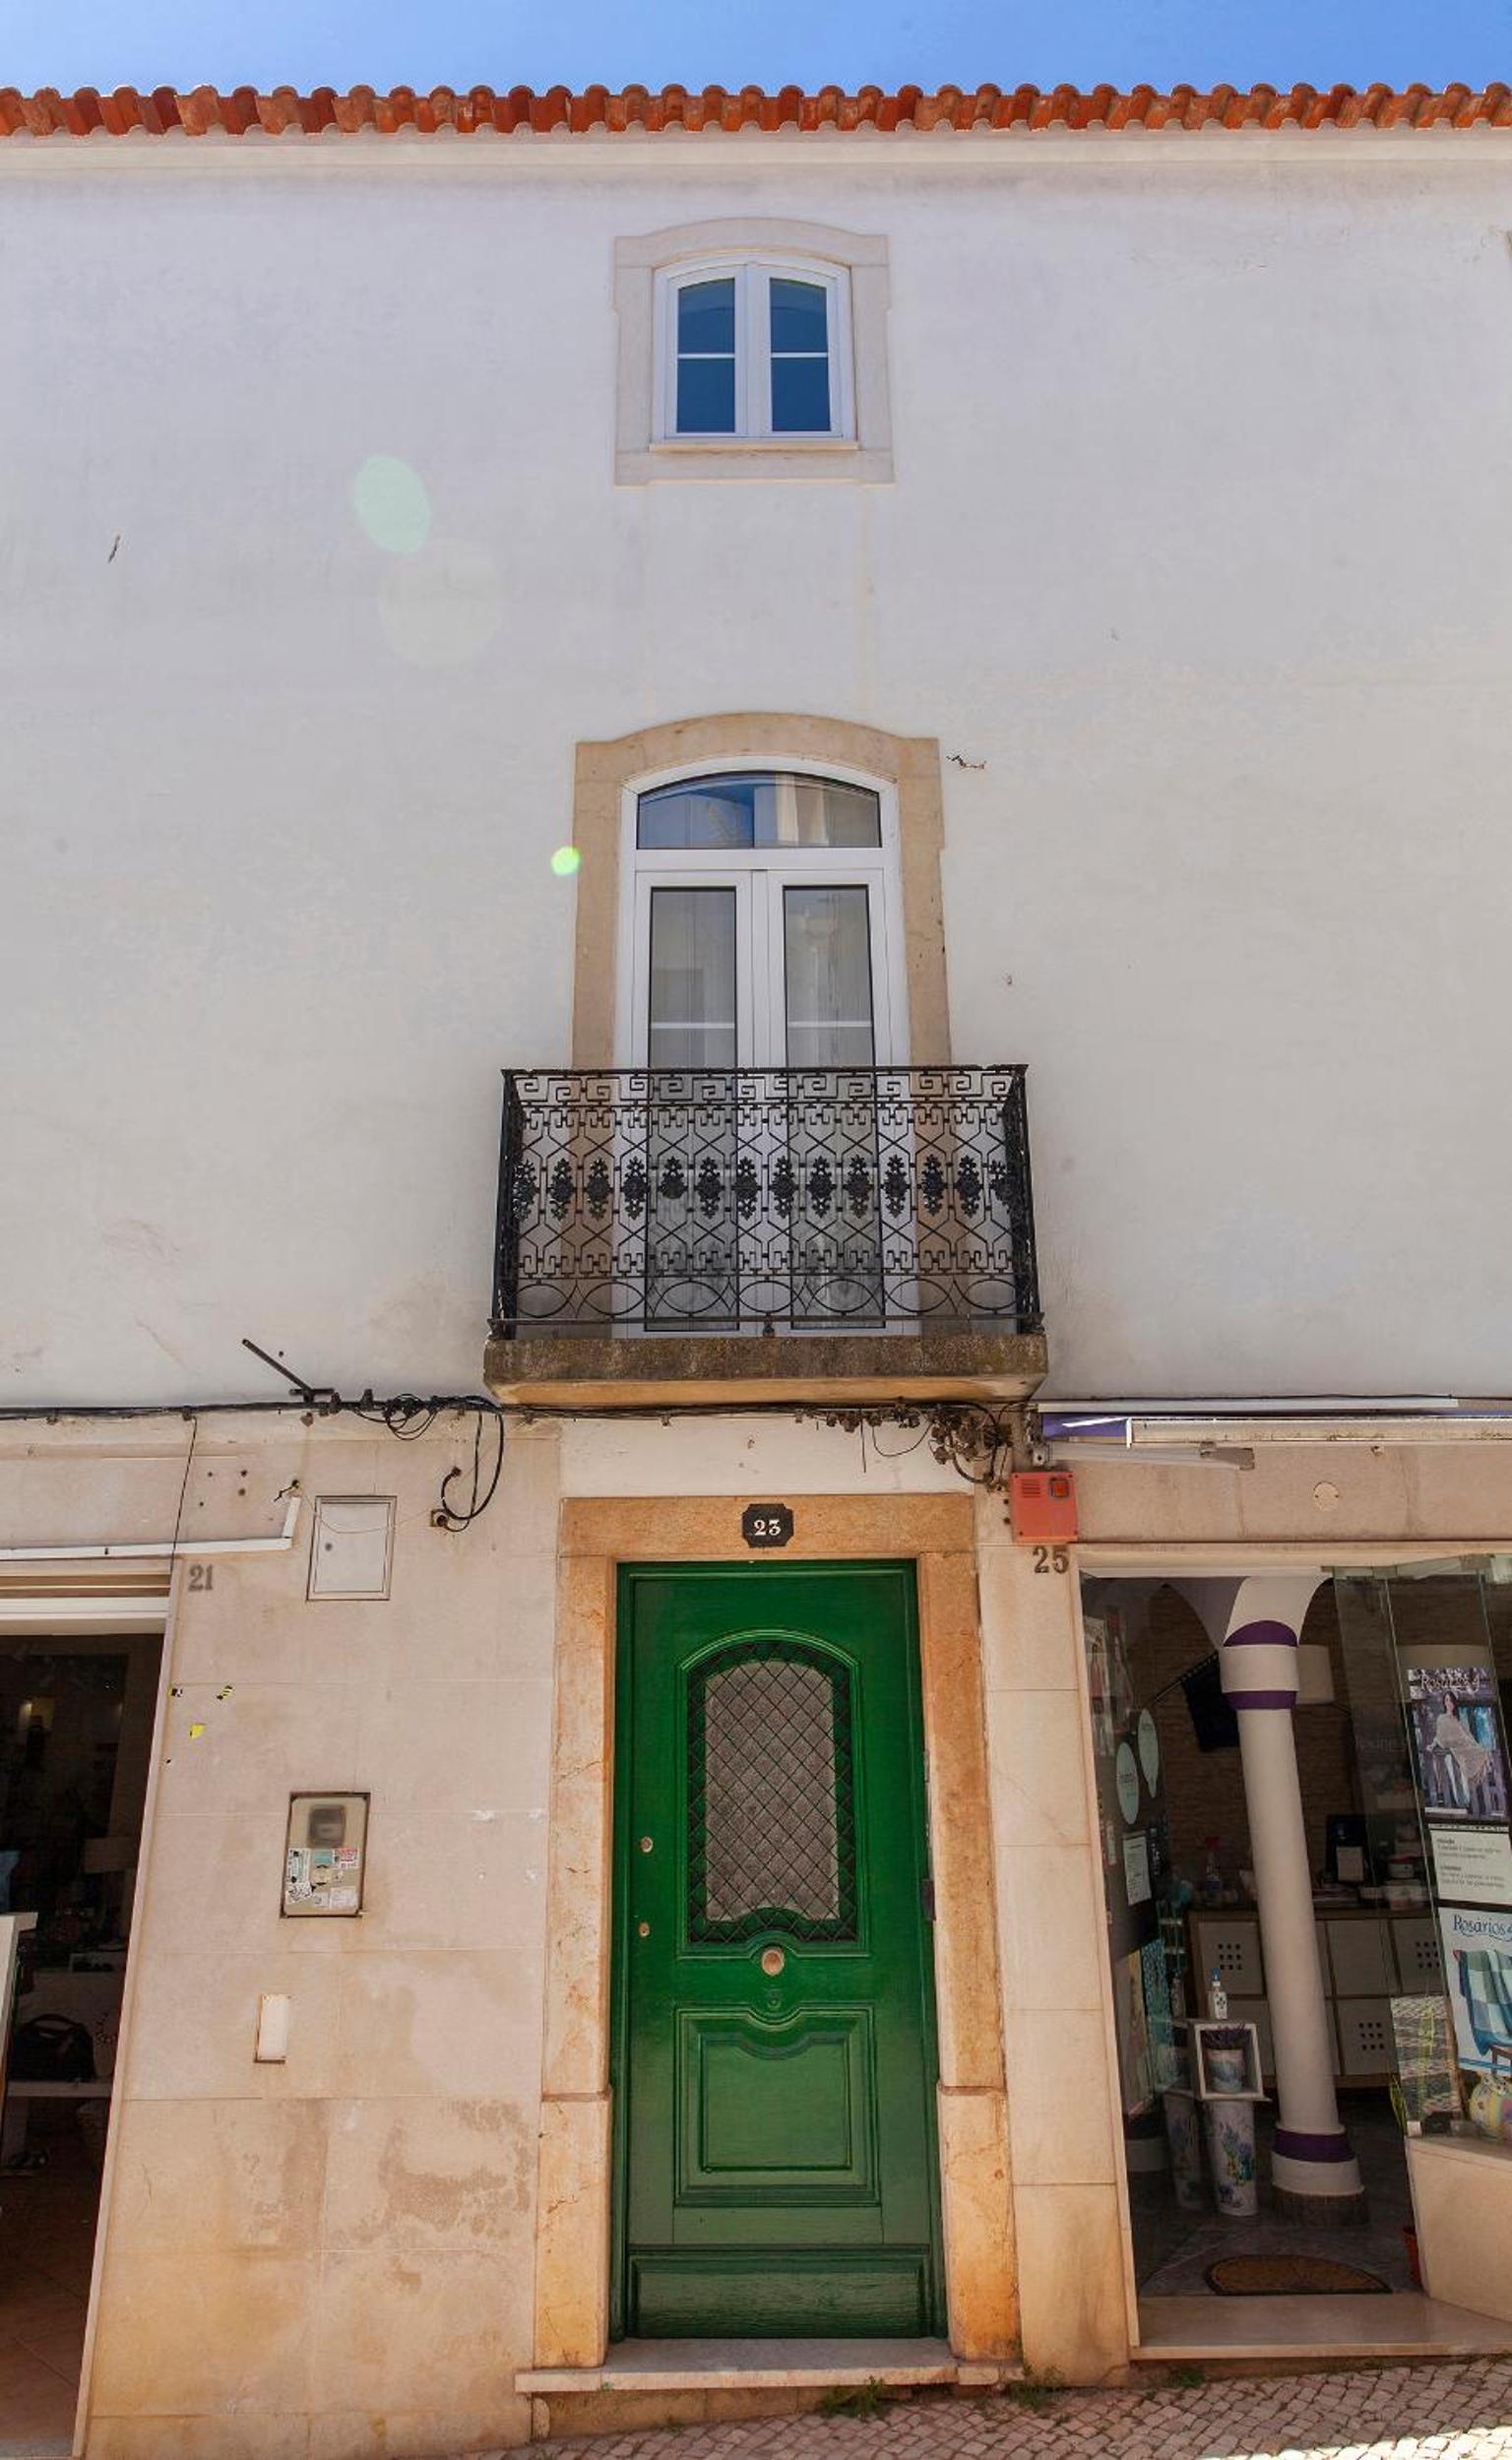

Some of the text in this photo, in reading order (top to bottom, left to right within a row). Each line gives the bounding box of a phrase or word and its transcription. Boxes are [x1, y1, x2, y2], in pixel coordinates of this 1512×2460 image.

[754, 1519, 782, 1536] 23
[1033, 1545, 1069, 1574] 25
[188, 1563, 213, 1592] 21
